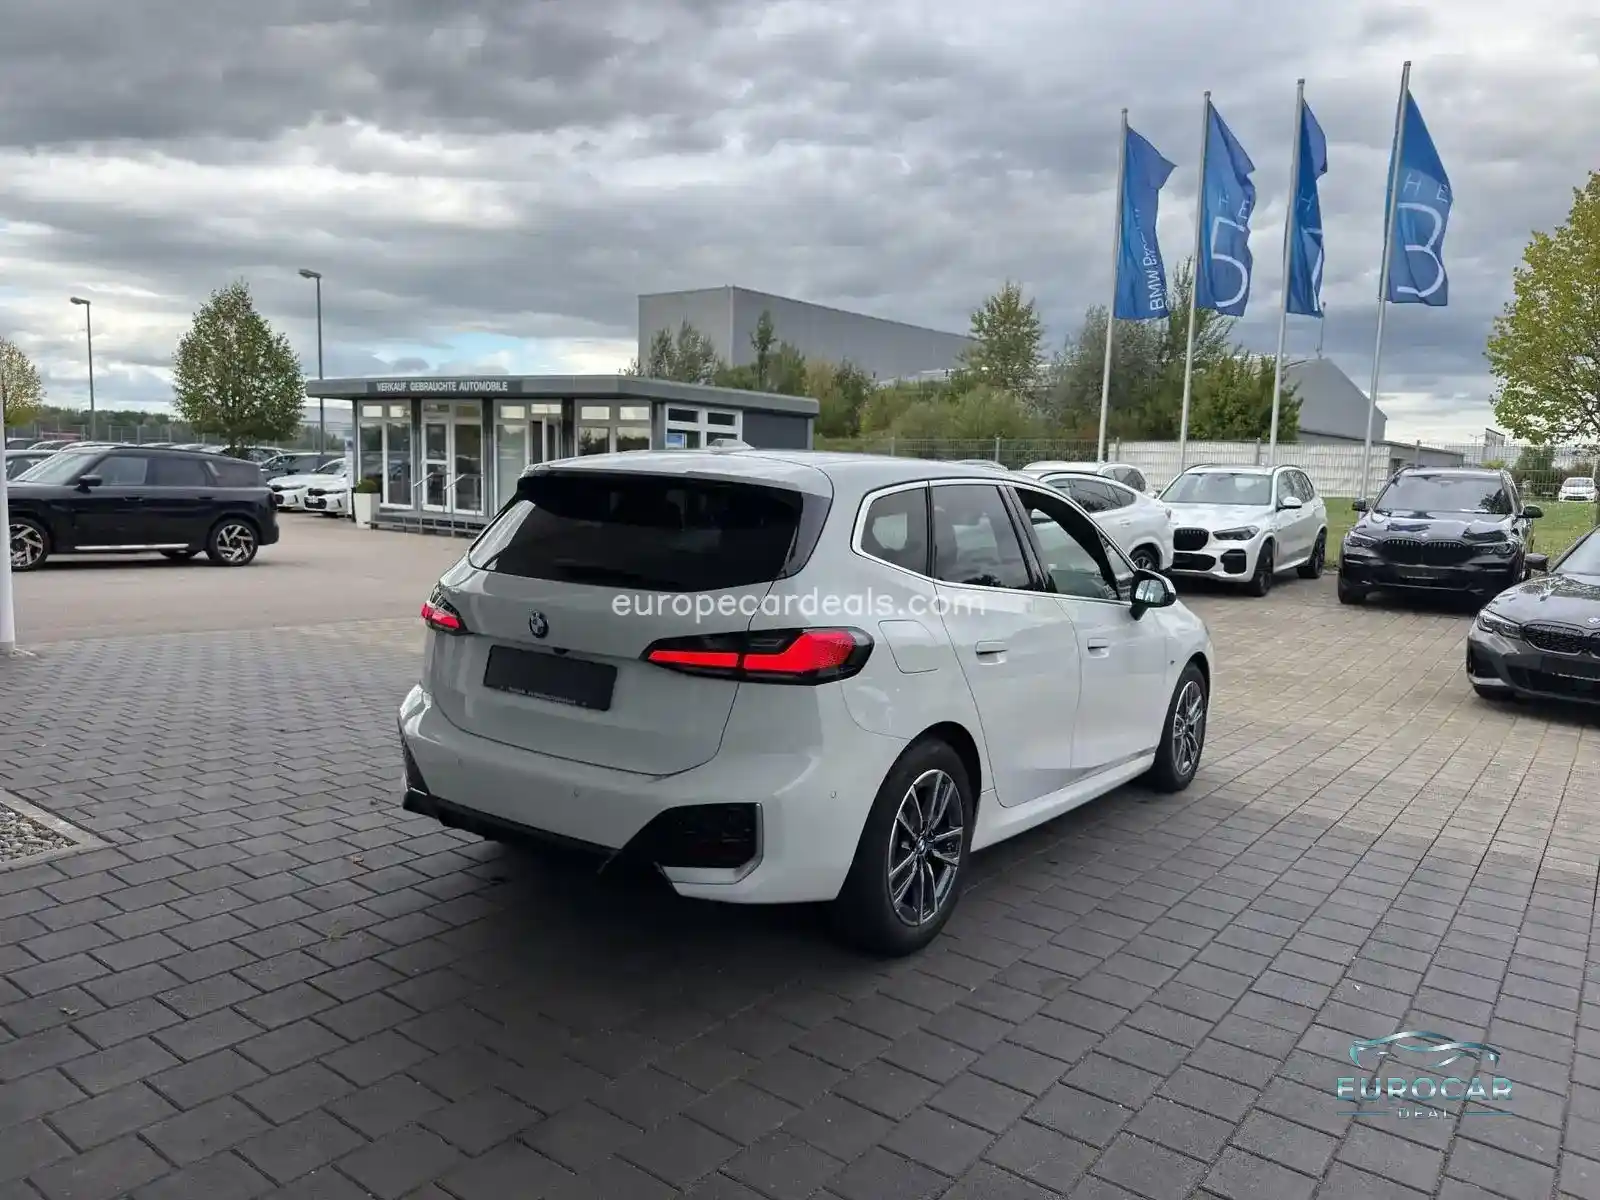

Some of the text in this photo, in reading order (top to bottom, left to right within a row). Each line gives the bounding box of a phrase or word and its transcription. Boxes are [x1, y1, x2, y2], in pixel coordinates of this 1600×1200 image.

[1210, 216, 1248, 307] 5
[1397, 202, 1444, 298] 3
[1146, 269, 1165, 311] BMW
[376, 380, 508, 392] VERKAUF GEBRAUCHTE AUTOMOBILE
